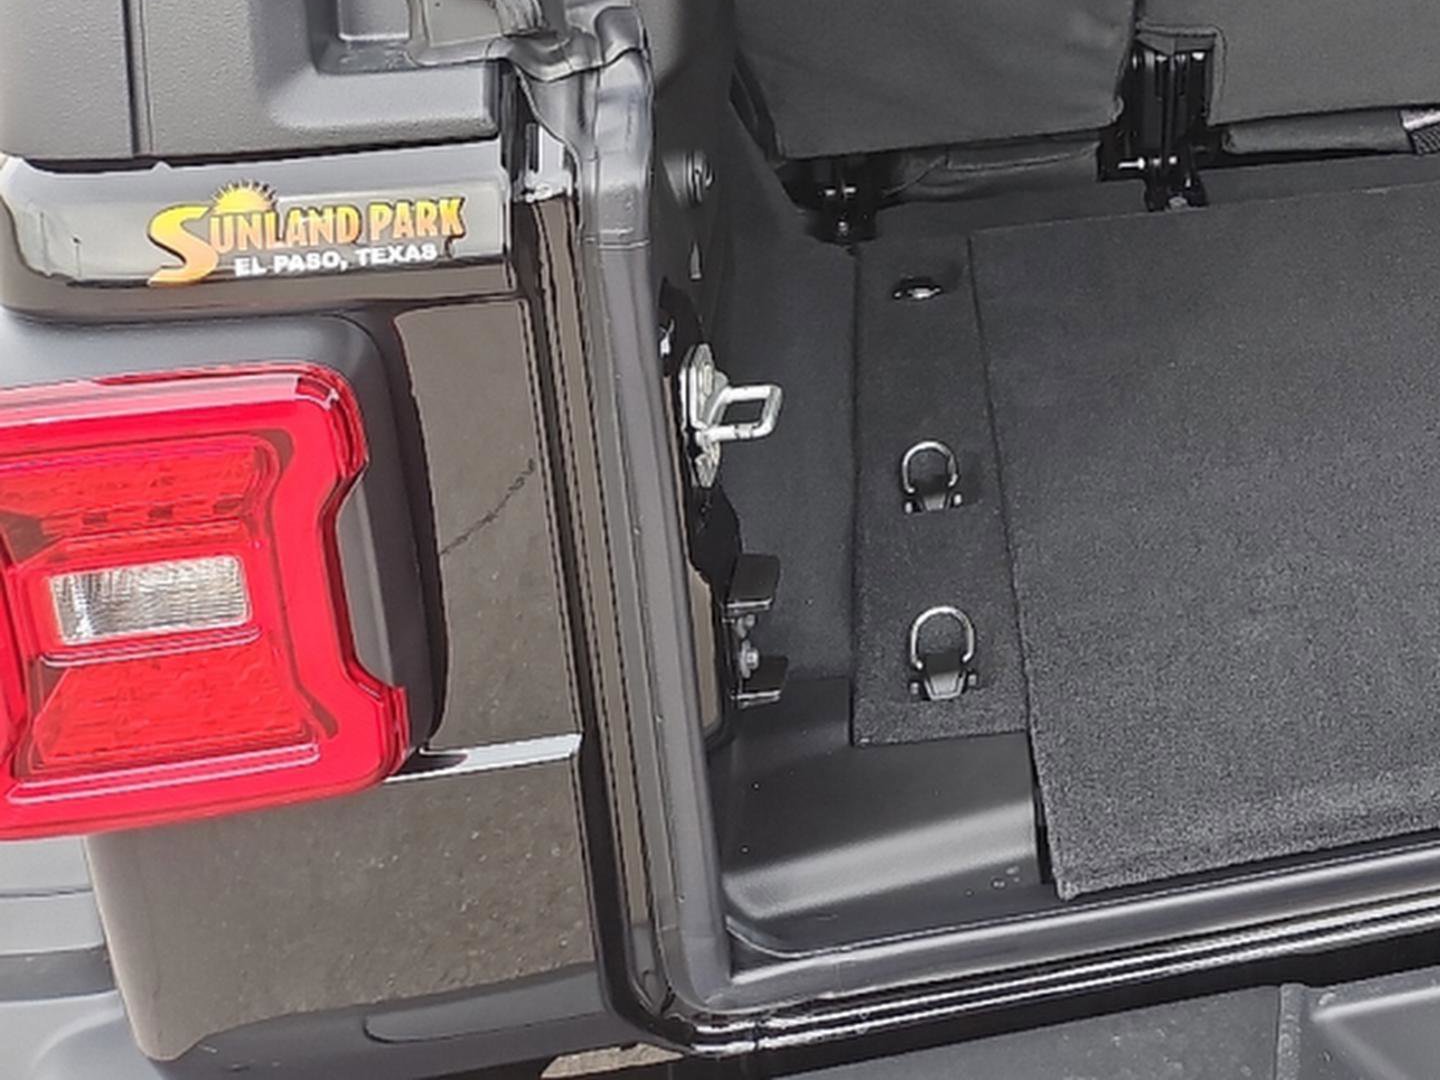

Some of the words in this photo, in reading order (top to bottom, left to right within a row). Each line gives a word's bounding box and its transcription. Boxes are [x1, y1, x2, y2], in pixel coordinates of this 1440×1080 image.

[147, 204, 361, 284] SUNLAND
[368, 197, 465, 240] PARK
[234, 258, 267, 277] EL
[274, 250, 348, 273] PASO,
[355, 242, 438, 266] TEXAS
